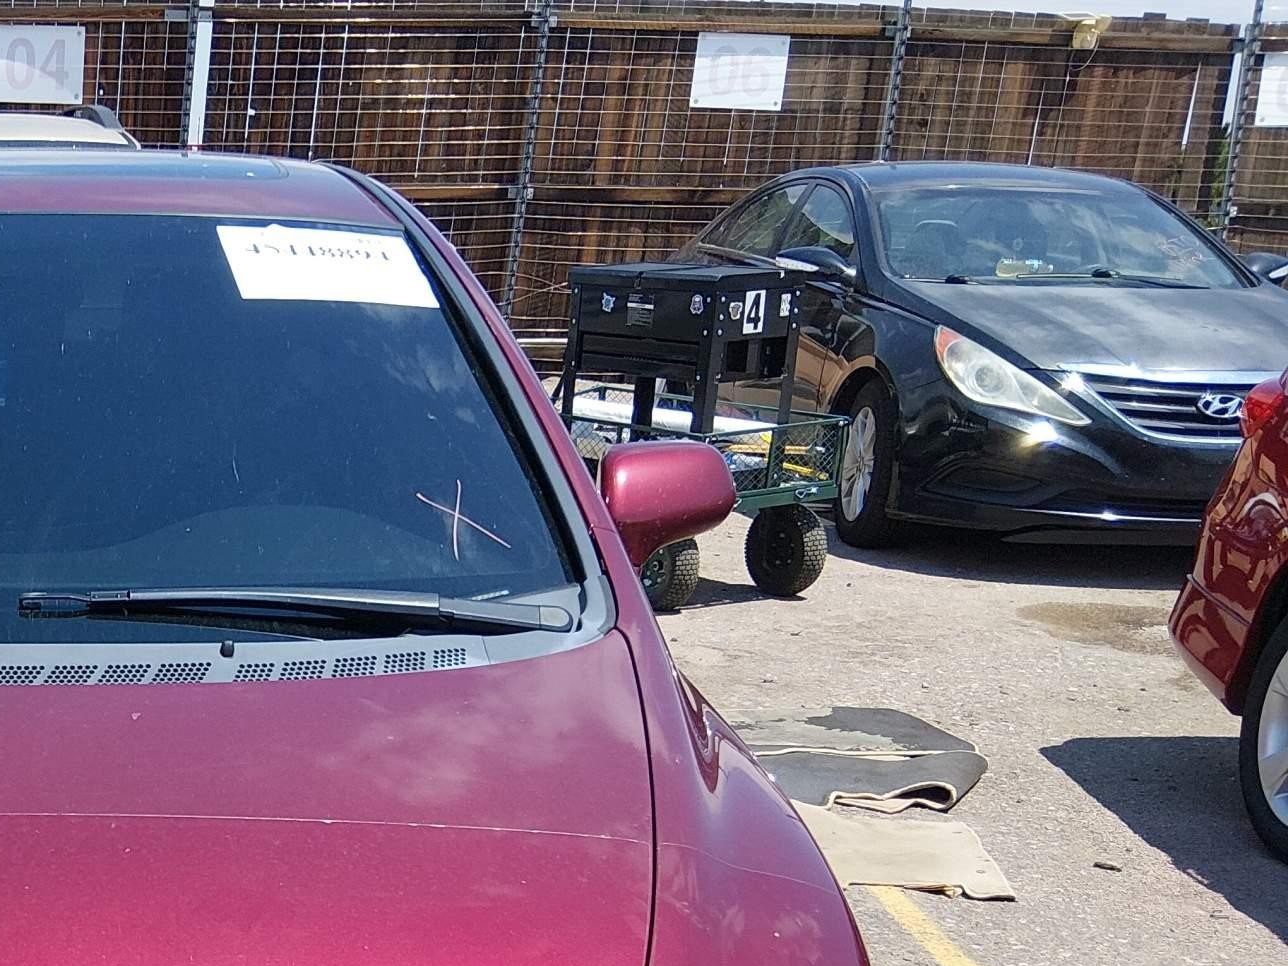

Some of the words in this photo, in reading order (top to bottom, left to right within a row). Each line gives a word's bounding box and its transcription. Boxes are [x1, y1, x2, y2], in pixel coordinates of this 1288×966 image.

[6, 37, 69, 90] 04
[708, 45, 772, 97] 06
[745, 292, 762, 331] 4
